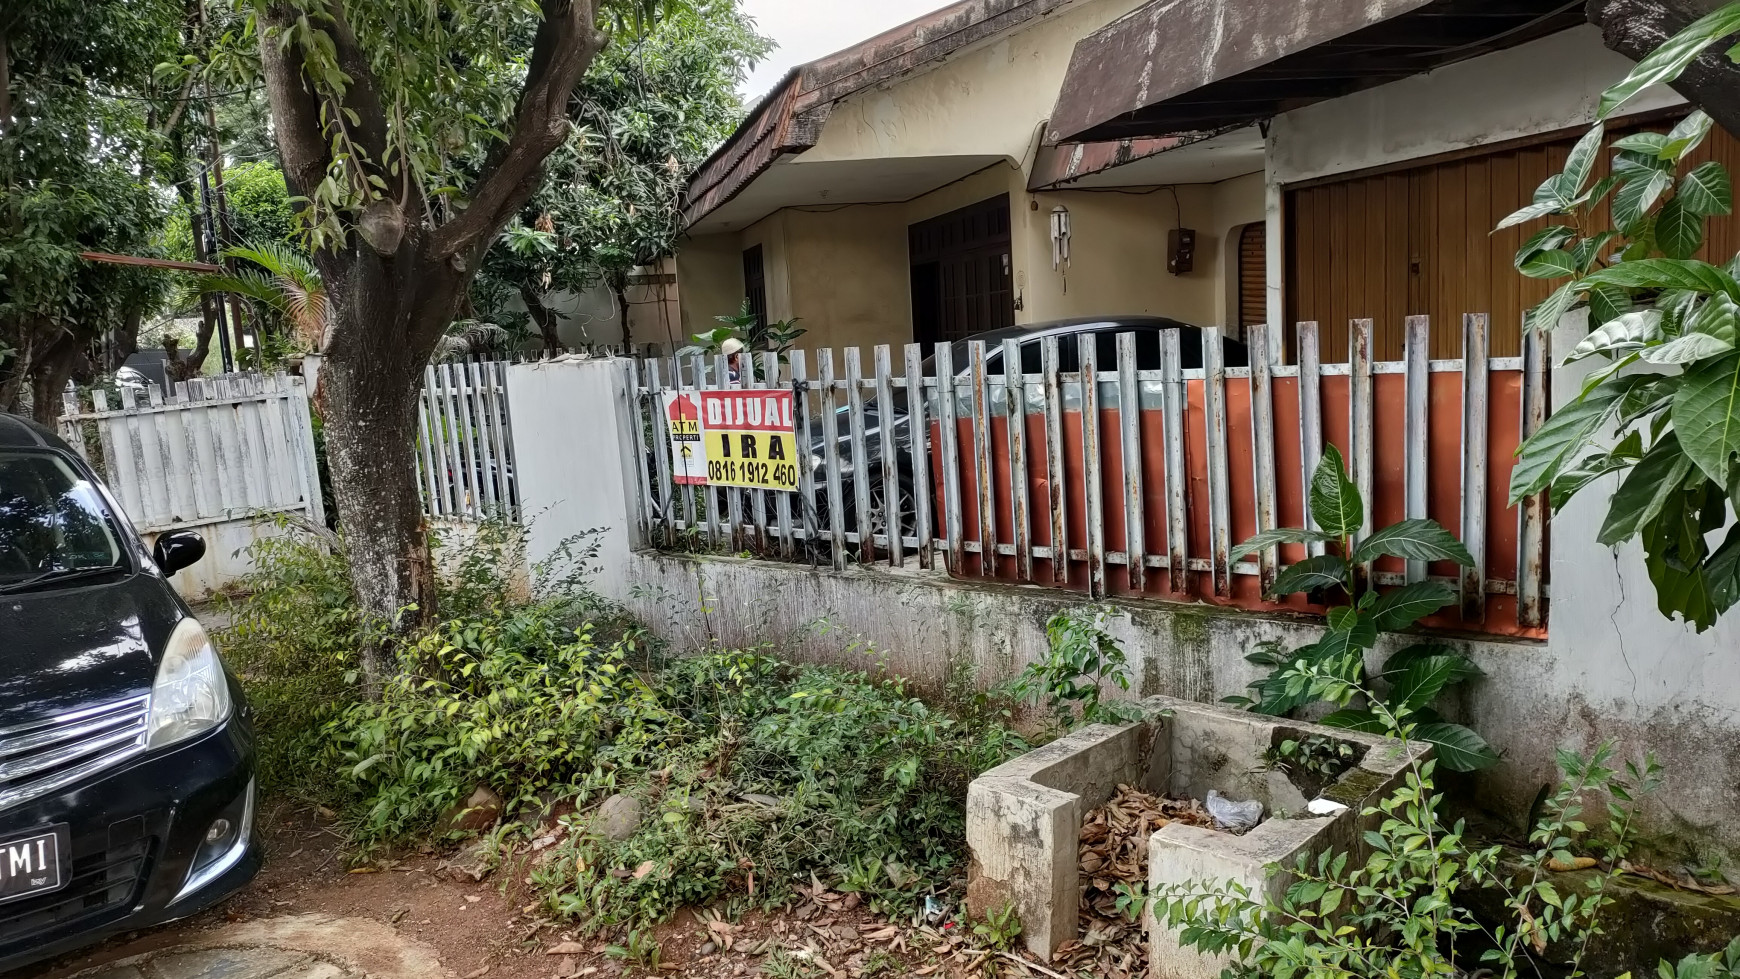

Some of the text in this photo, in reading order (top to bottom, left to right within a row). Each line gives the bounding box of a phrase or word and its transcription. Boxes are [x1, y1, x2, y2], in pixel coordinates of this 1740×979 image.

[706, 397, 793, 427] DIJUAL
[672, 421, 698, 432] ATM
[721, 433, 785, 460] IRA
[708, 460, 796, 486] 0816 1912 460
